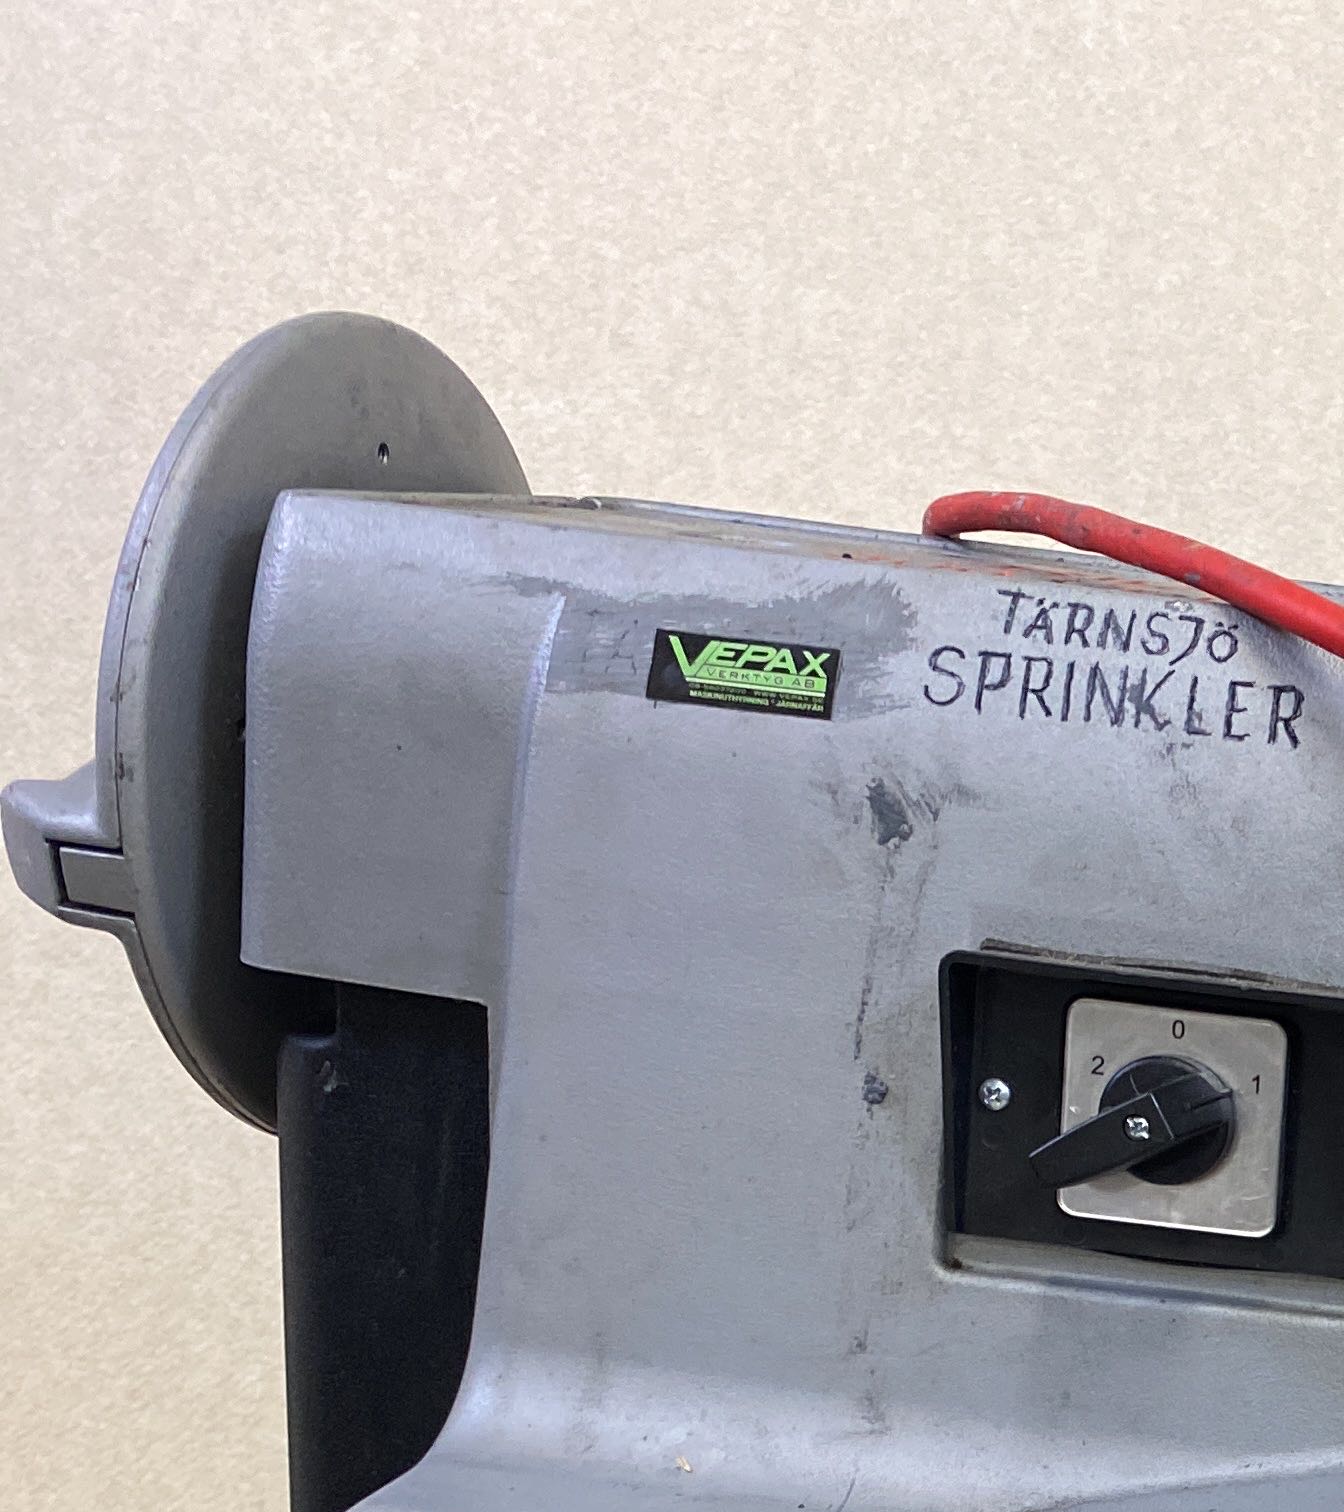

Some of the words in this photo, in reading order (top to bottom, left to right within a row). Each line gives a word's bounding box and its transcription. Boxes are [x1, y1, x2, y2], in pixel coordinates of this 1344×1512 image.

[997, 588, 1239, 666] TÄRNSJÖ
[668, 635, 831, 678] VEPAX
[706, 667, 785, 685] VERKTYG
[791, 678, 815, 689] AB
[923, 645, 1305, 749] SPRINKLER
[1171, 1019, 1185, 1039] 0
[1091, 1055, 1105, 1076] 2
[1251, 1074, 1261, 1094] 1
